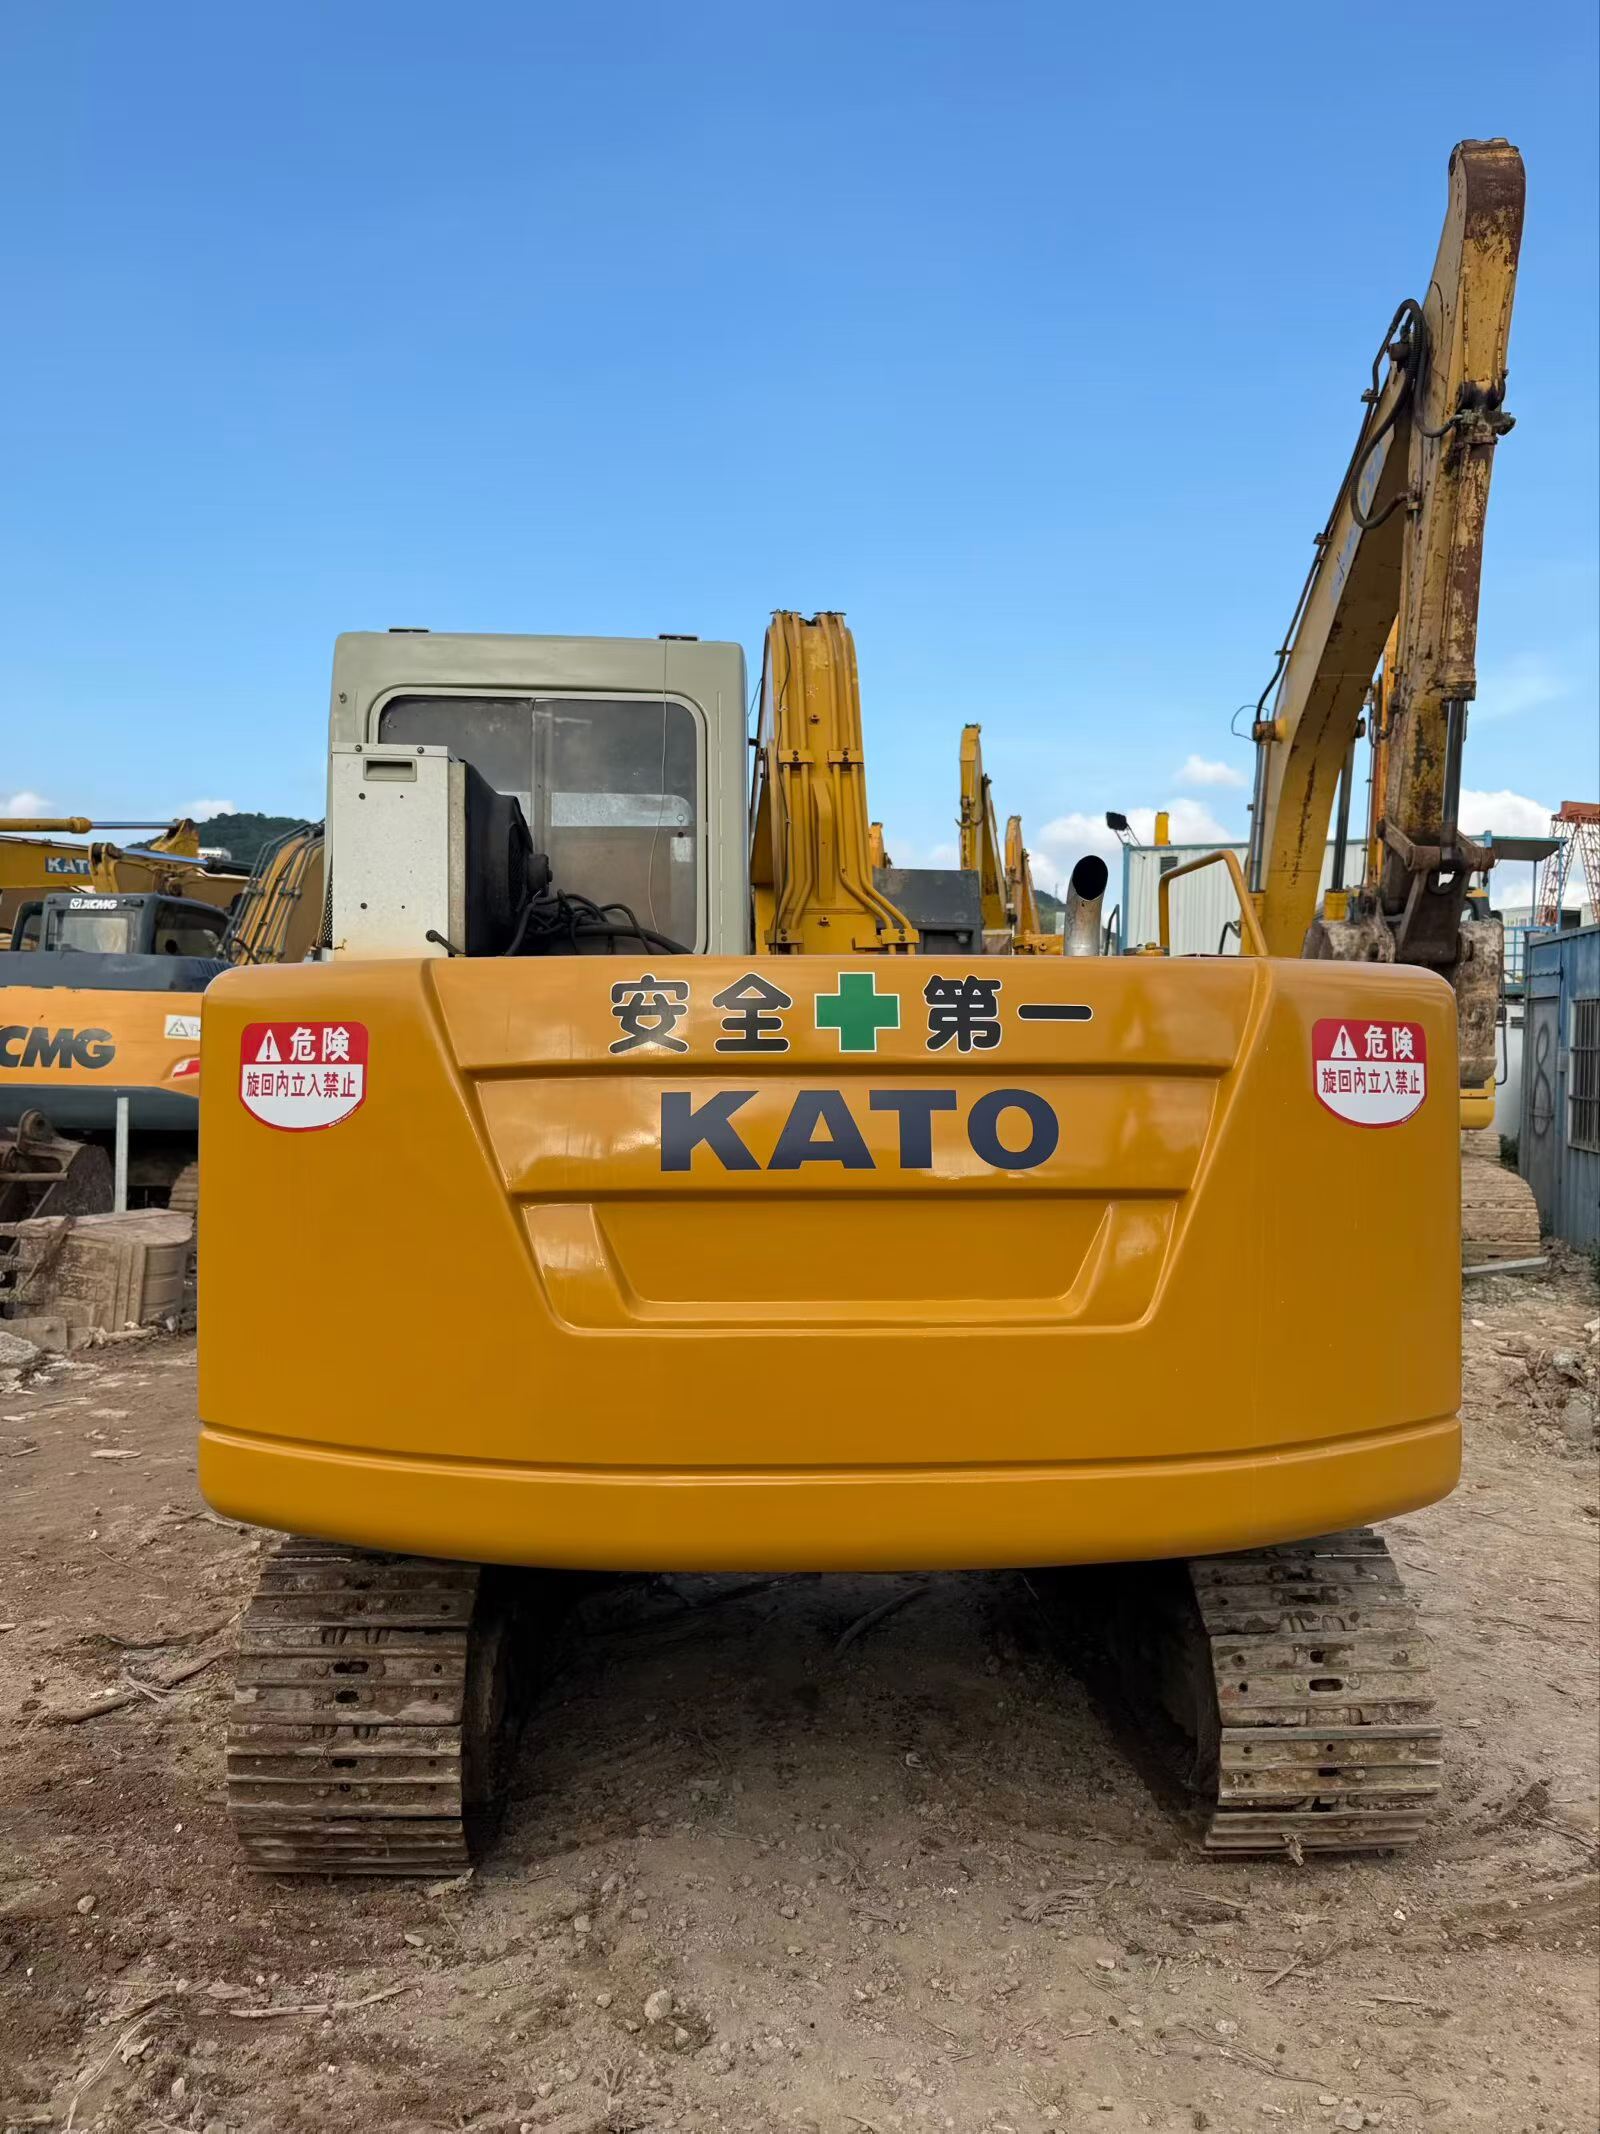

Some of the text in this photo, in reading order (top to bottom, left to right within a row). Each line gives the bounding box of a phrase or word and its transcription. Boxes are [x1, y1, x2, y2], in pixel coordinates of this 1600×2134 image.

[48, 857, 90, 874] KAT
[81, 899, 117, 910] XCMG
[609, 973, 1094, 1053] 安全 第一
[0, 1025, 115, 1069] CMG
[290, 1027, 350, 1062] 危険
[1364, 1025, 1415, 1060] 危険
[247, 1070, 356, 1098] 旋回内立入禁止
[1322, 1067, 1420, 1095] 旋回内立入禁止
[660, 1088, 1059, 1172] KATO
